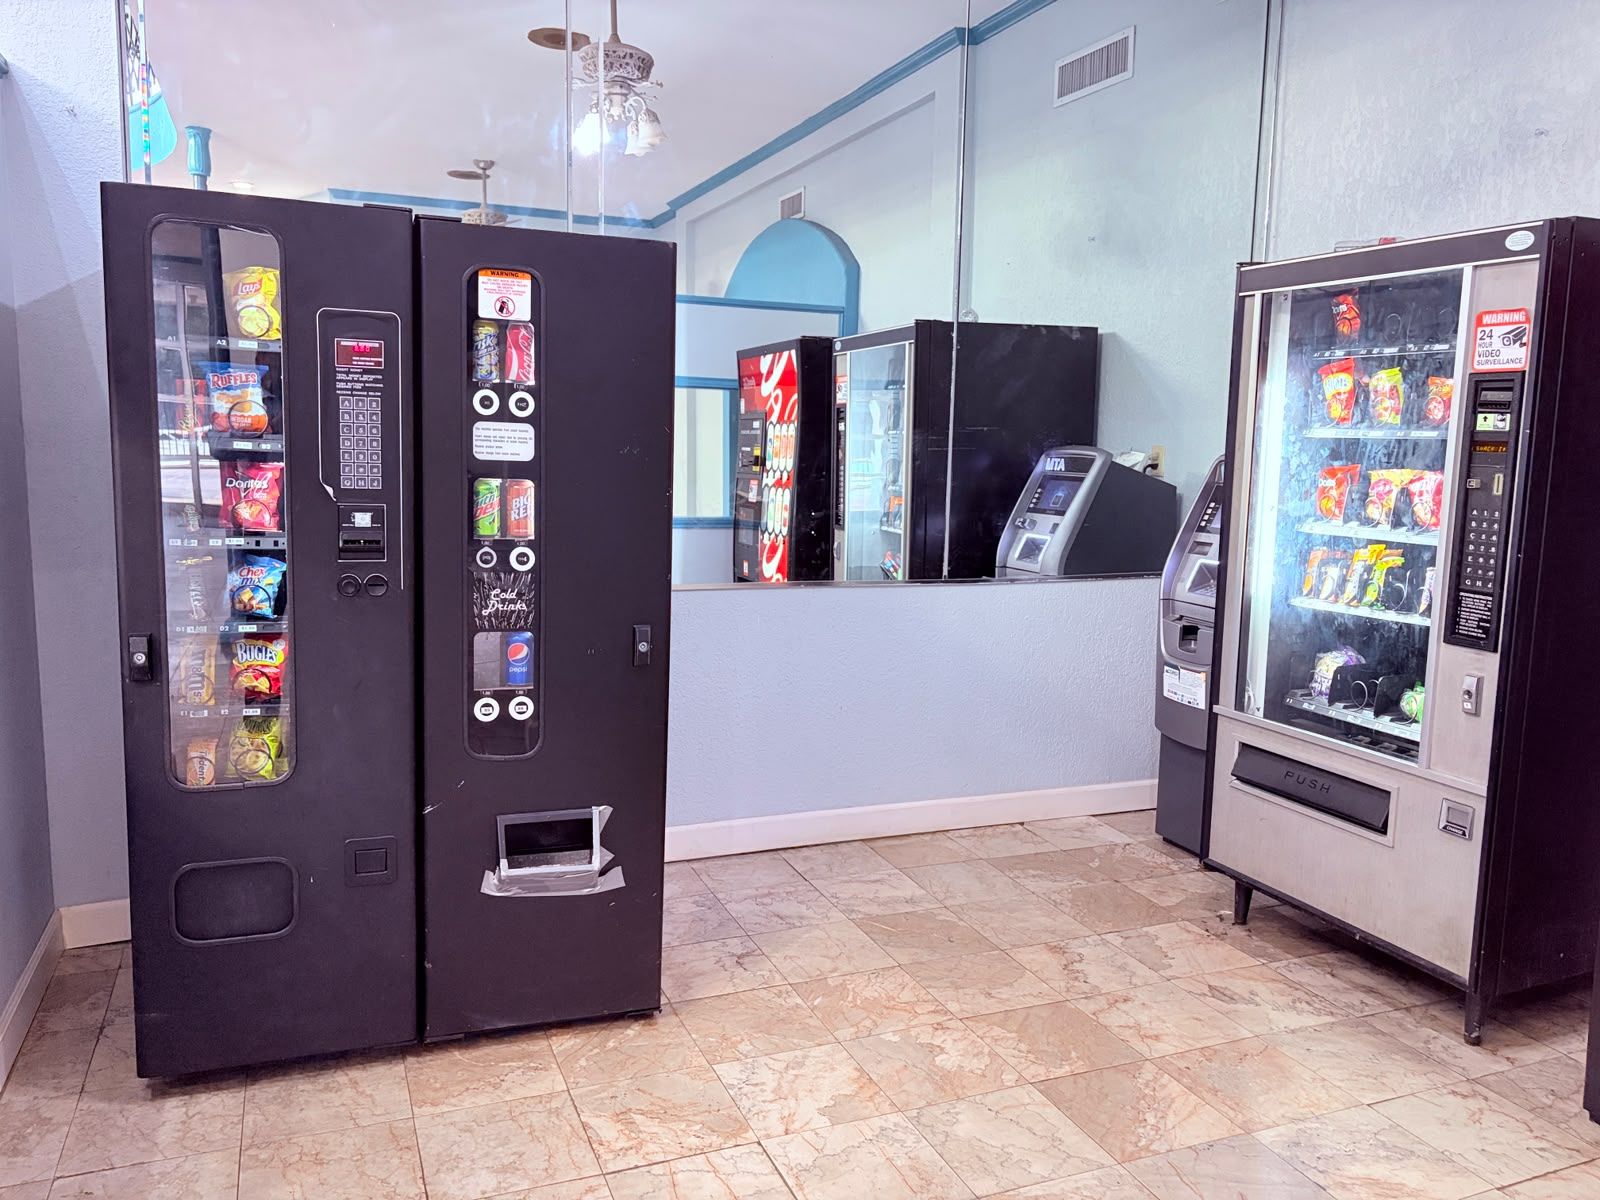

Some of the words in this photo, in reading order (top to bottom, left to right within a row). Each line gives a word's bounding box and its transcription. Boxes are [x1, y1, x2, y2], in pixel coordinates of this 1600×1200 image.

[490, 270, 519, 278] WARNING
[1482, 312, 1526, 325] WARNING
[1479, 329, 1494, 341] 24
[1478, 341, 1493, 349] HOUR
[1477, 349, 1501, 358] VIDEO
[1476, 357, 1523, 366] SURVEILLANCE
[210, 372, 257, 388] RUFFLES
[225, 477, 269, 489] Doritos
[511, 506, 528, 520] RE
[239, 566, 265, 578] Chex
[241, 576, 262, 586] mix
[490, 589, 517, 600] Cold
[482, 600, 527, 616] Drinks
[236, 642, 278, 663] BUGLES
[1284, 770, 1332, 793] PUSH
